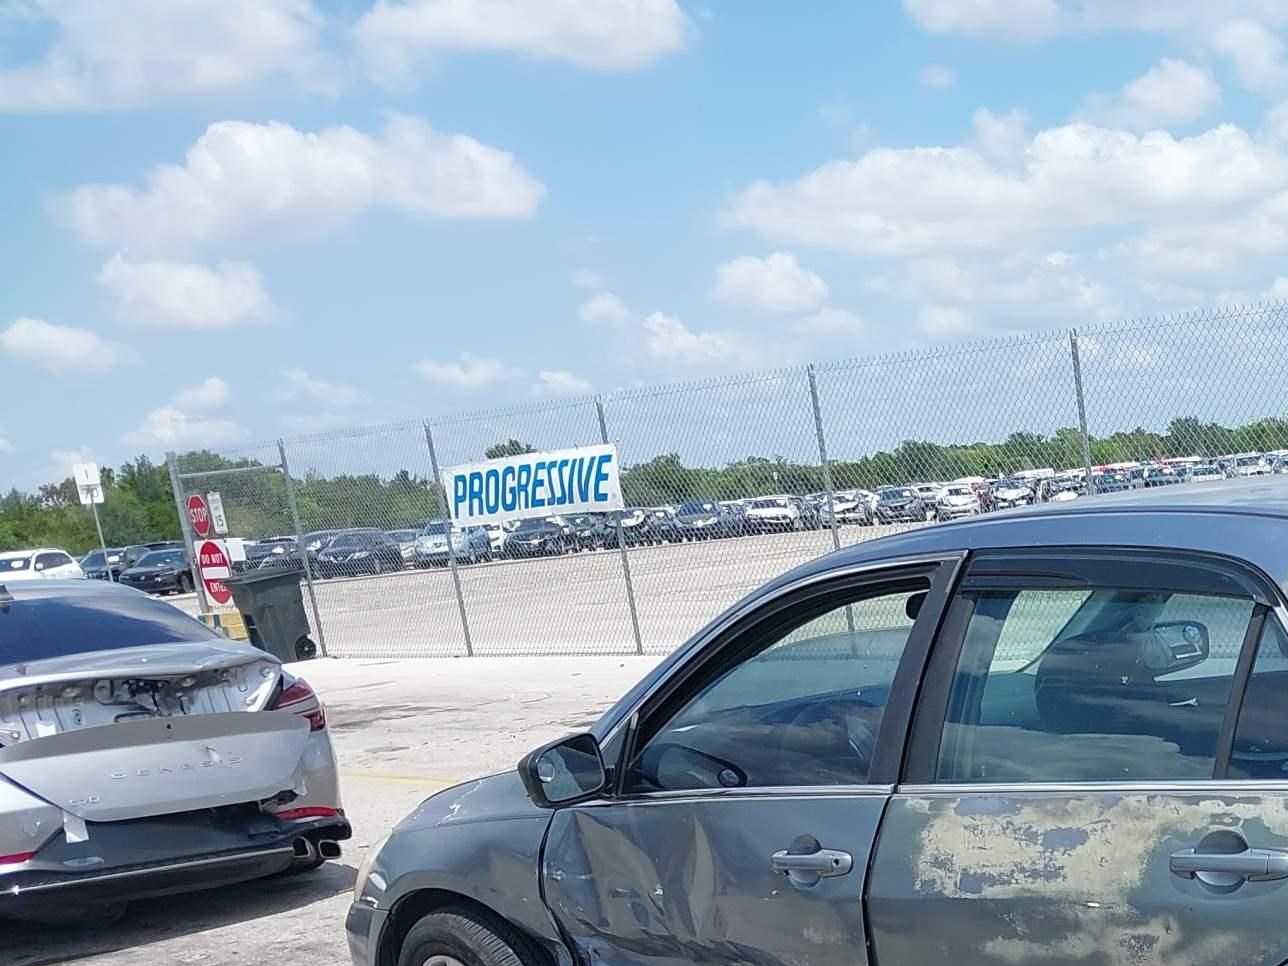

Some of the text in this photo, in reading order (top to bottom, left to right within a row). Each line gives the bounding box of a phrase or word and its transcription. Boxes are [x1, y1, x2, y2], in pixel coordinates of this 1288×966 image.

[453, 454, 613, 519] PROGRESSIVE
[190, 508, 207, 524] STOP
[201, 553, 224, 565] DO NOT
[111, 756, 243, 780] GENESIS
